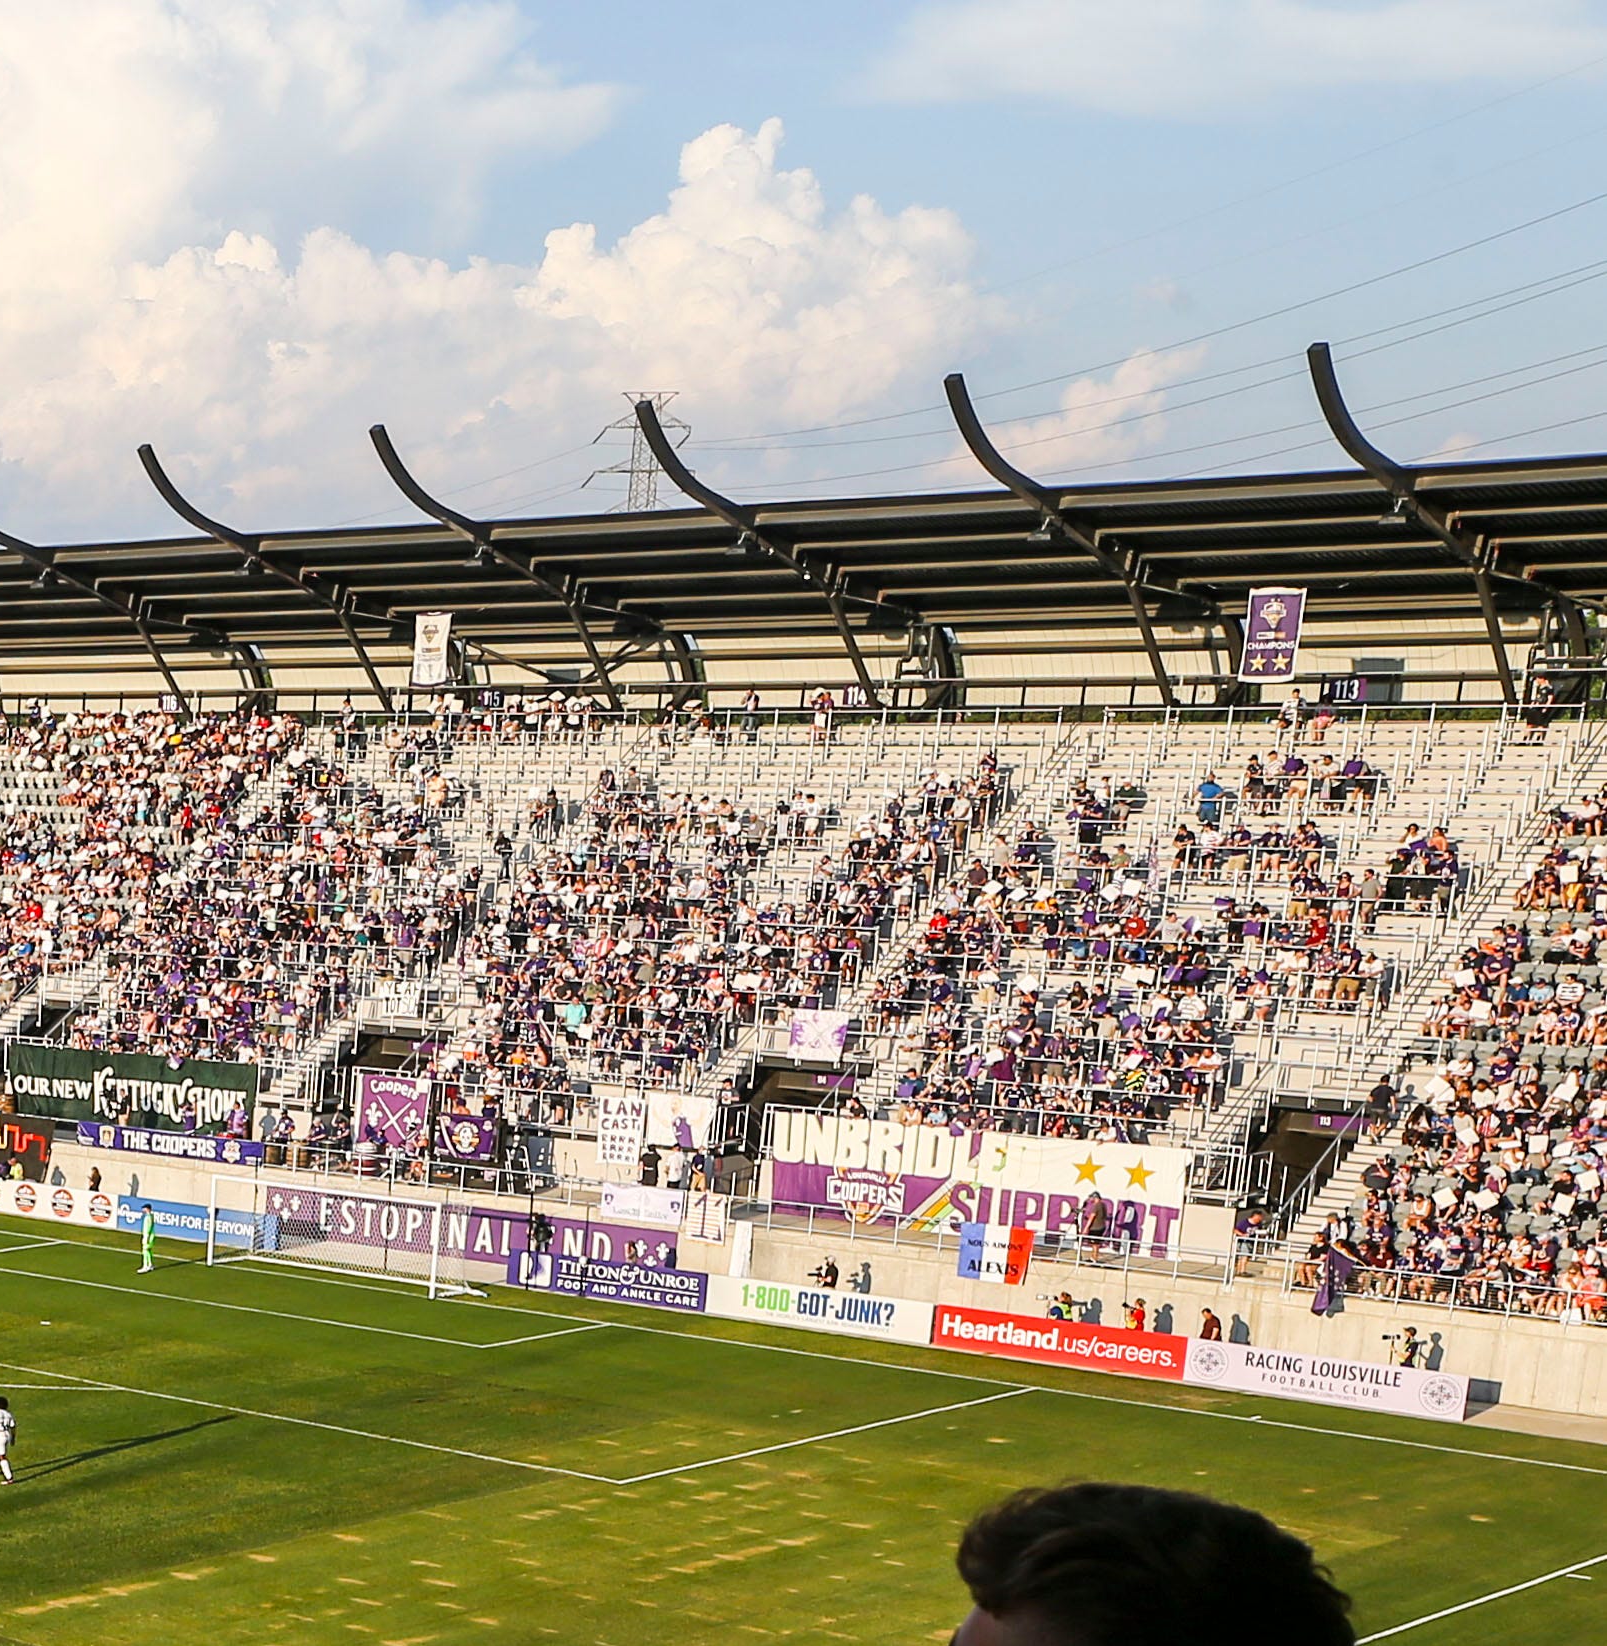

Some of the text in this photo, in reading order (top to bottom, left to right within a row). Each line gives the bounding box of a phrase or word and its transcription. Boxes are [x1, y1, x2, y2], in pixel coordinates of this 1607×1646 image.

[1247, 639, 1296, 651] CHAMPIONS
[484, 691, 500, 707] 115
[847, 686, 867, 705] 114
[1334, 679, 1359, 700] 113
[162, 695, 177, 711] 116
[13, 1075, 50, 1096] OUR
[51, 1078, 93, 1101] NEW
[370, 1079, 420, 1101] Coopers
[121, 1129, 217, 1159] THE COOPERS
[830, 1179, 902, 1208] COOPERS
[181, 1213, 202, 1229] FOR
[967, 1259, 1019, 1277] ALEXIS
[592, 1284, 616, 1296] AND
[621, 1288, 660, 1302] ANKLE
[664, 1293, 699, 1307] CARE
[742, 1283, 895, 1328] 1-800-GOT-JUNK?
[941, 1313, 1176, 1368] Heartland.us/careers.
[1246, 1350, 1303, 1374] RACING
[1310, 1360, 1402, 1388] LOUISVILLE
[1261, 1372, 1335, 1394] FOOTBALL
